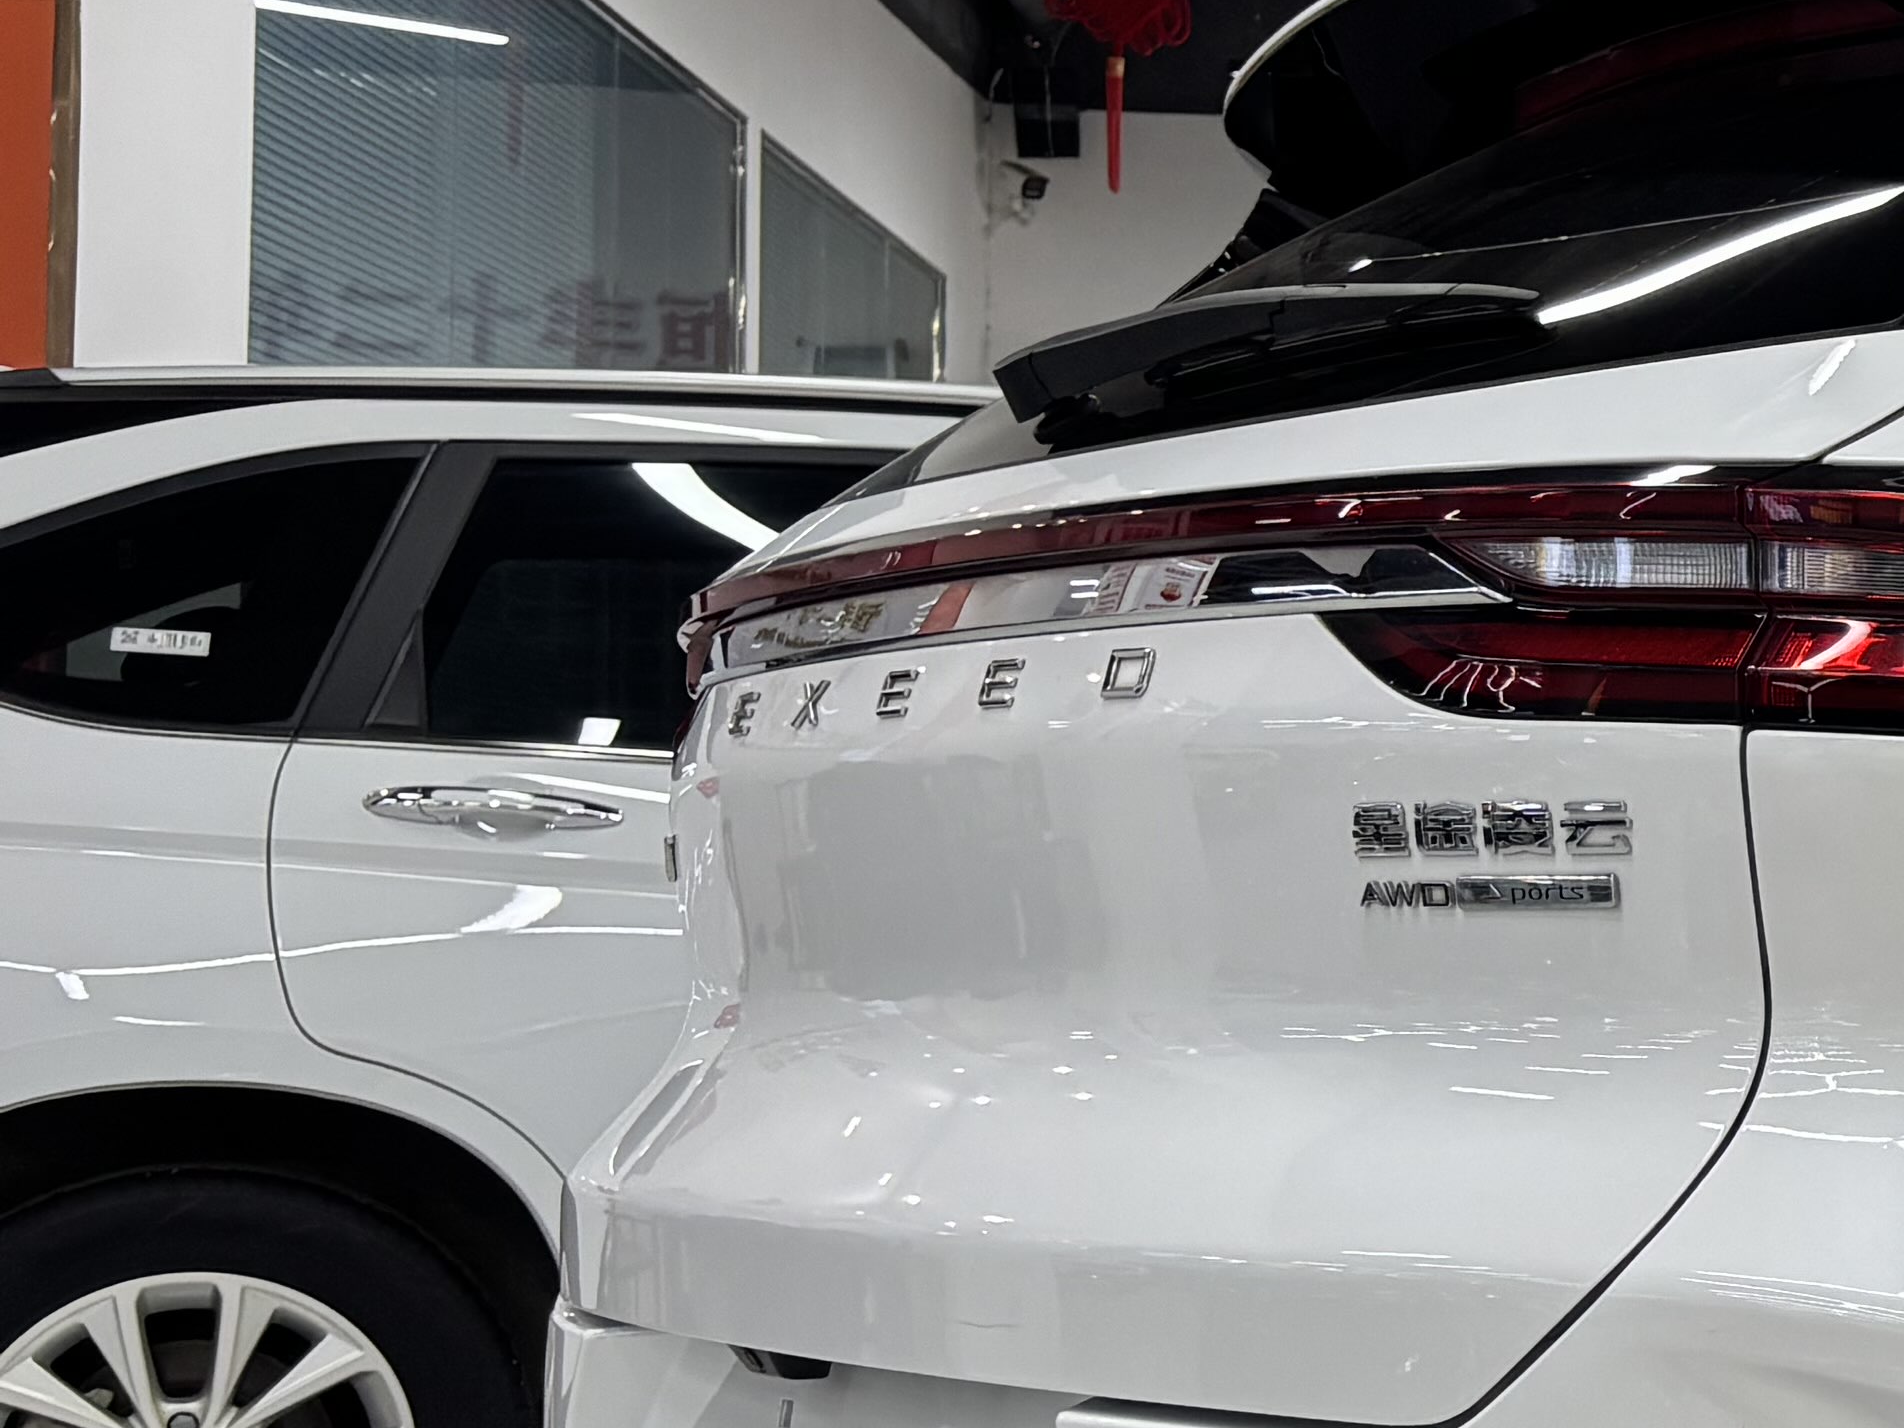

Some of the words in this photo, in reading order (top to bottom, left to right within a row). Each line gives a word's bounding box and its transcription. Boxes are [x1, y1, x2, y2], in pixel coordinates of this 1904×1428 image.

[728, 647, 1157, 738] EXEED
[1352, 800, 1634, 859] 星途凌云
[1360, 879, 1456, 908] AWD
